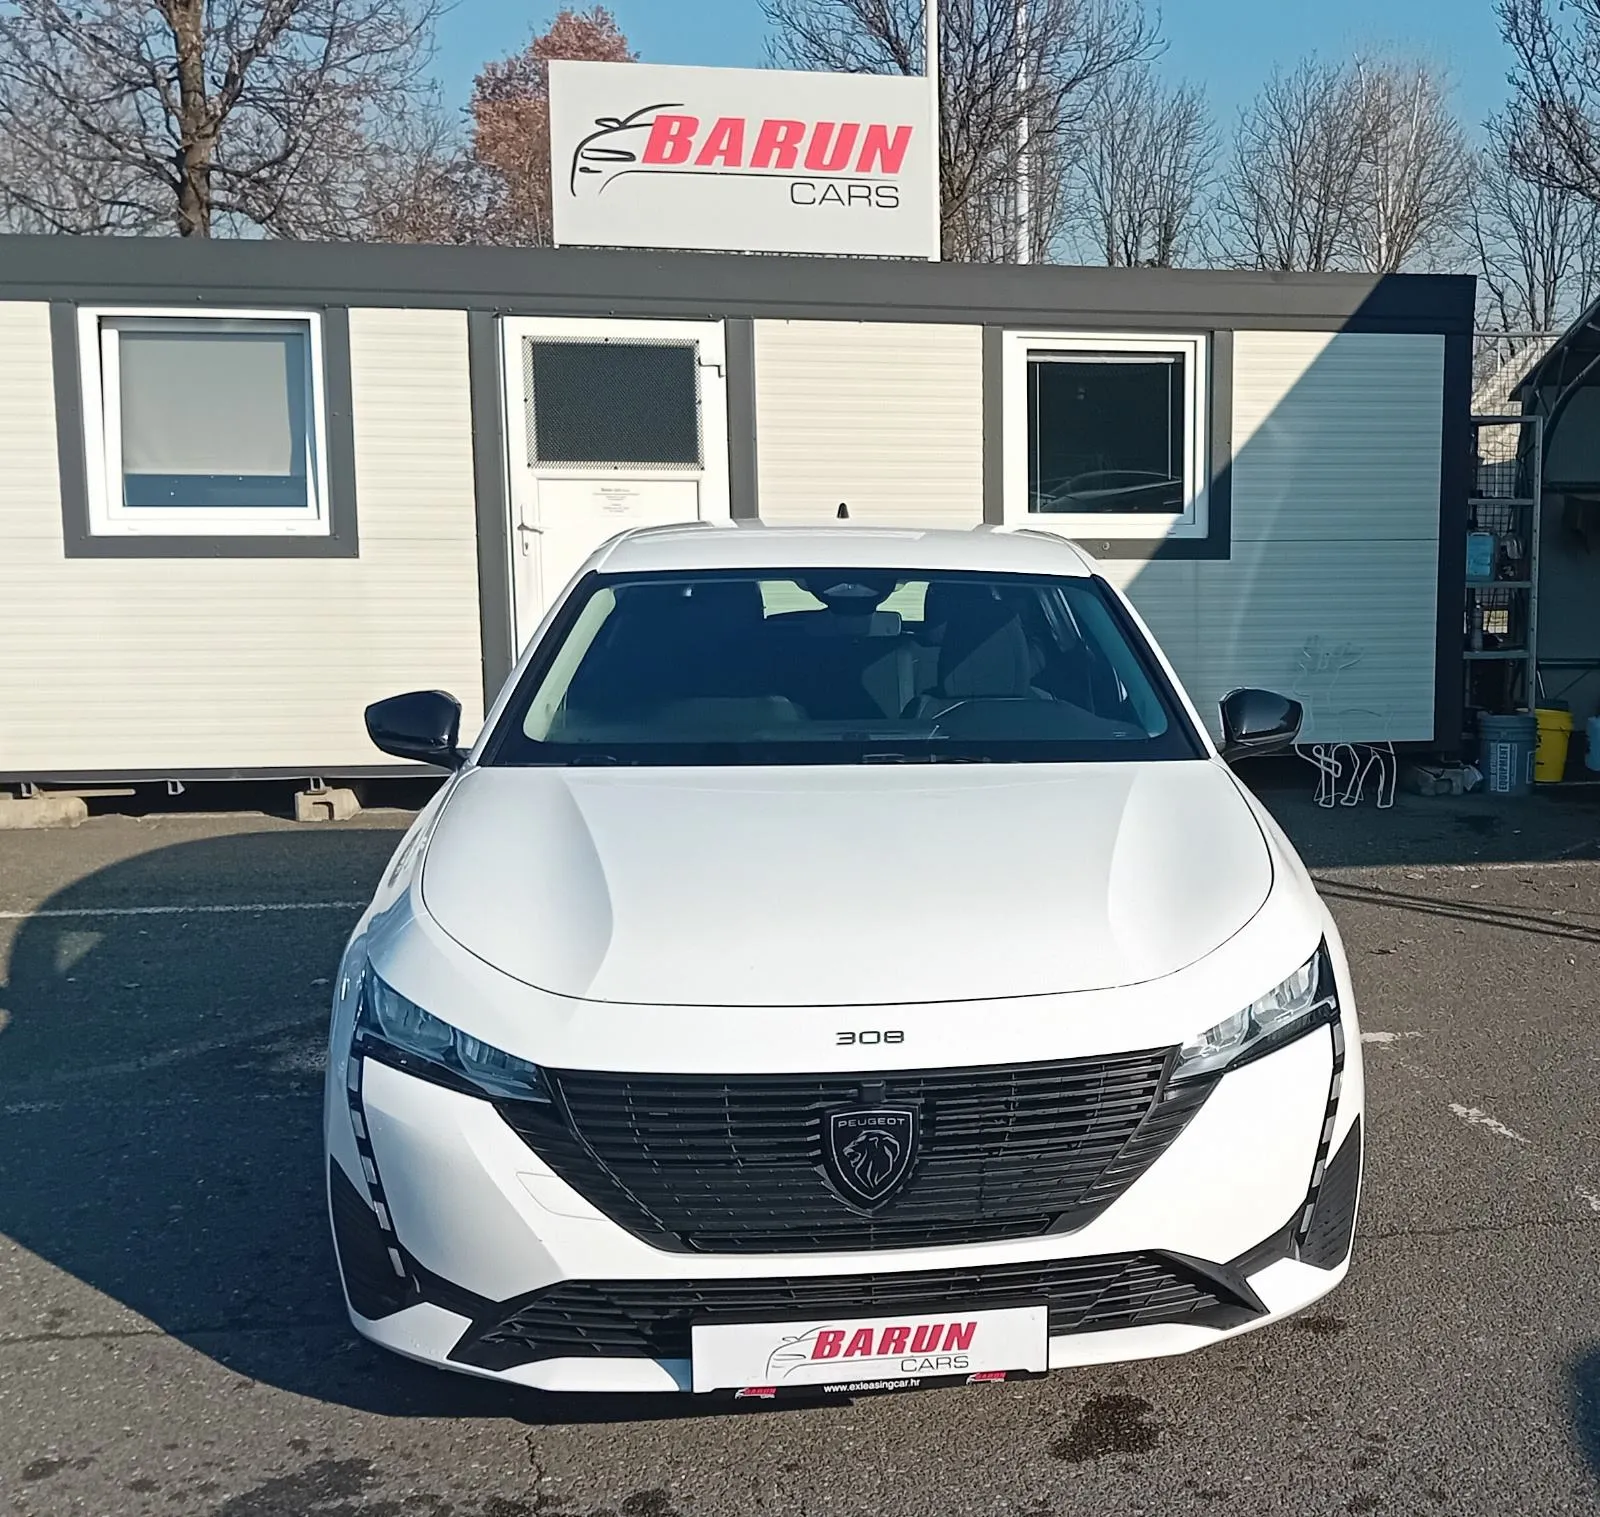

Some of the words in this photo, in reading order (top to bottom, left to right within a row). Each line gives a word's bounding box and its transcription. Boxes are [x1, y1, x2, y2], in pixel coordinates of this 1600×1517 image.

[641, 114, 913, 174] BARUN
[790, 182, 900, 209] CARS
[836, 1030, 905, 1046] 308
[838, 1117, 906, 1128] PEUGEOT
[811, 1321, 978, 1361] BARUN
[901, 1355, 970, 1373] CARS
[823, 1378, 921, 1394] www.exleasingcar.hr
